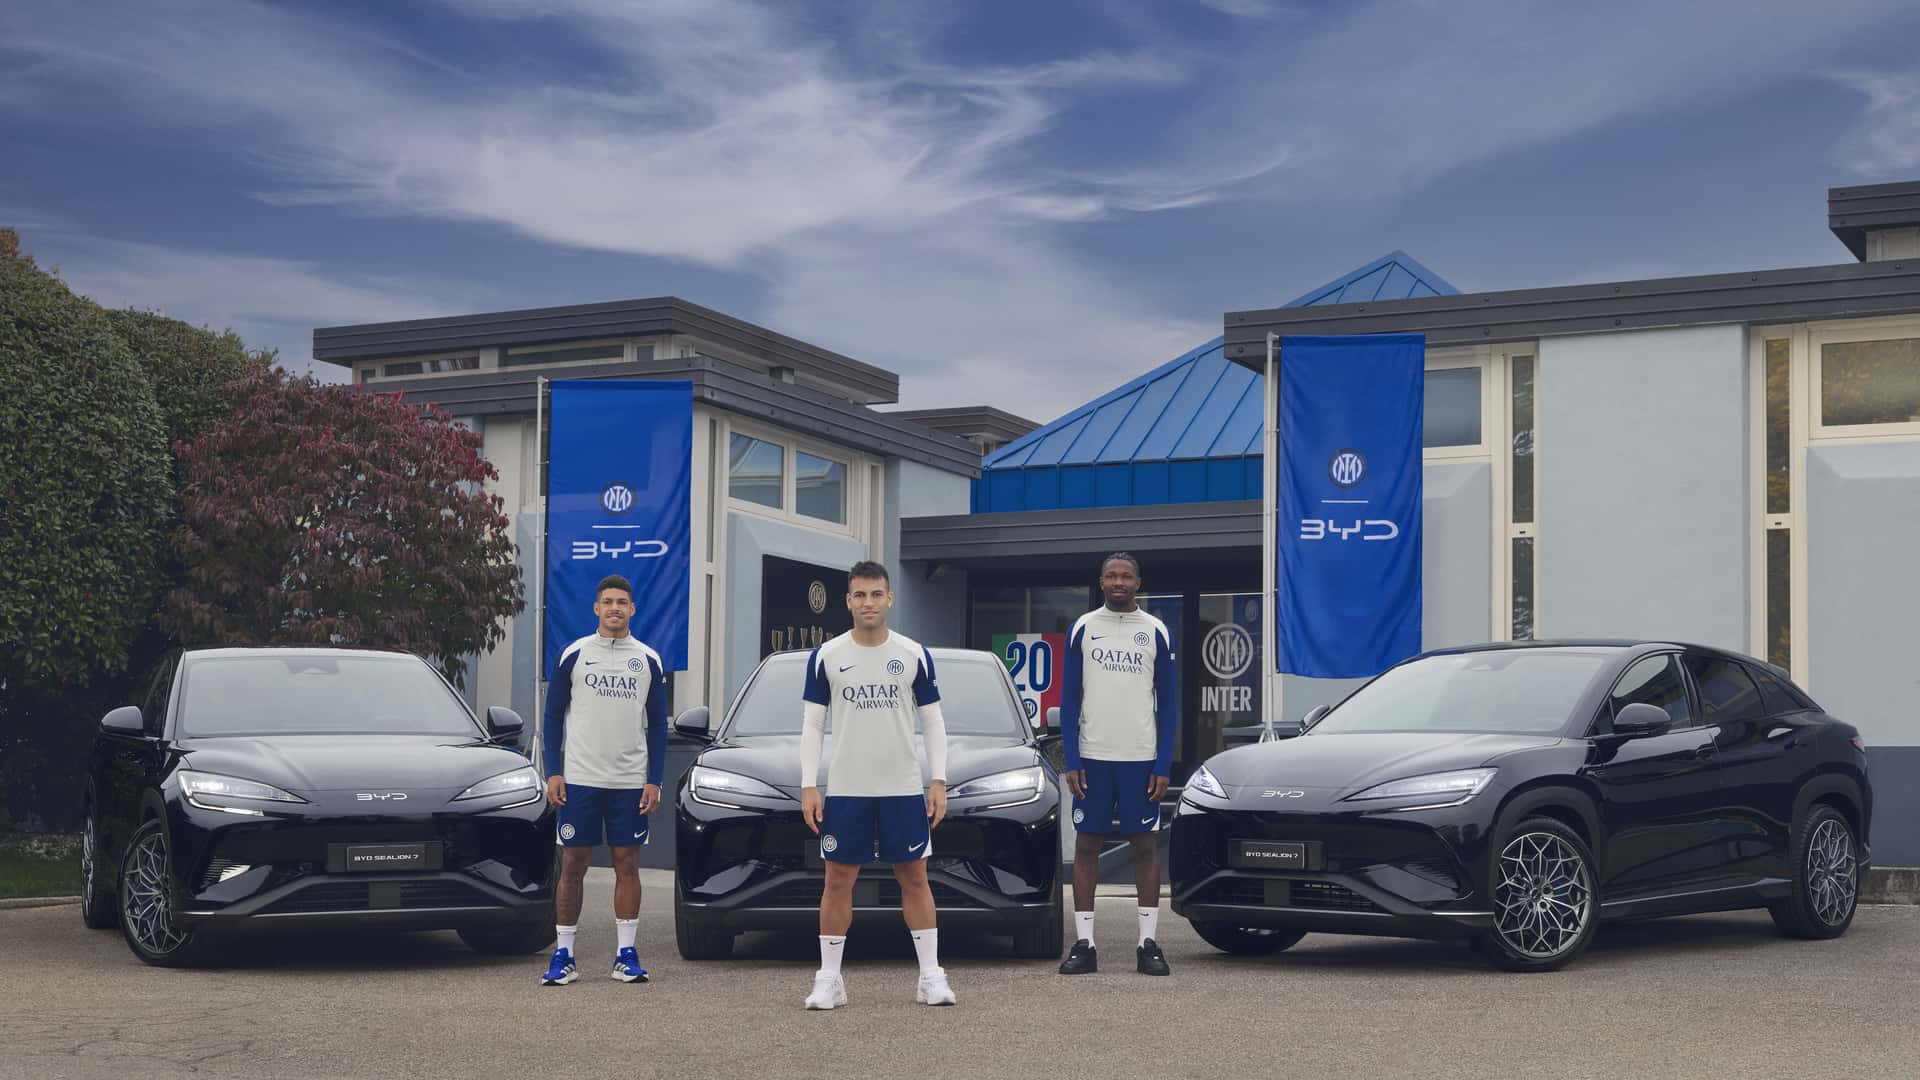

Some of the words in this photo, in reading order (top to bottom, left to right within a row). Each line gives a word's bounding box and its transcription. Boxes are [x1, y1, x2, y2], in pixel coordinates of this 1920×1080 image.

[1300, 519, 1399, 540] BYD
[572, 539, 669, 560] BYD
[1091, 647, 1143, 665] QATAR
[1005, 641, 1053, 693] 20
[1102, 662, 1143, 674] AIRWAYS
[584, 672, 638, 691] QATAR
[596, 687, 638, 700] AIRWAYS
[842, 684, 899, 701] QATAR
[1201, 686, 1252, 712] INTER
[855, 699, 900, 711] AIRWAYS
[356, 792, 408, 801] BYD
[1261, 790, 1304, 798] BYD
